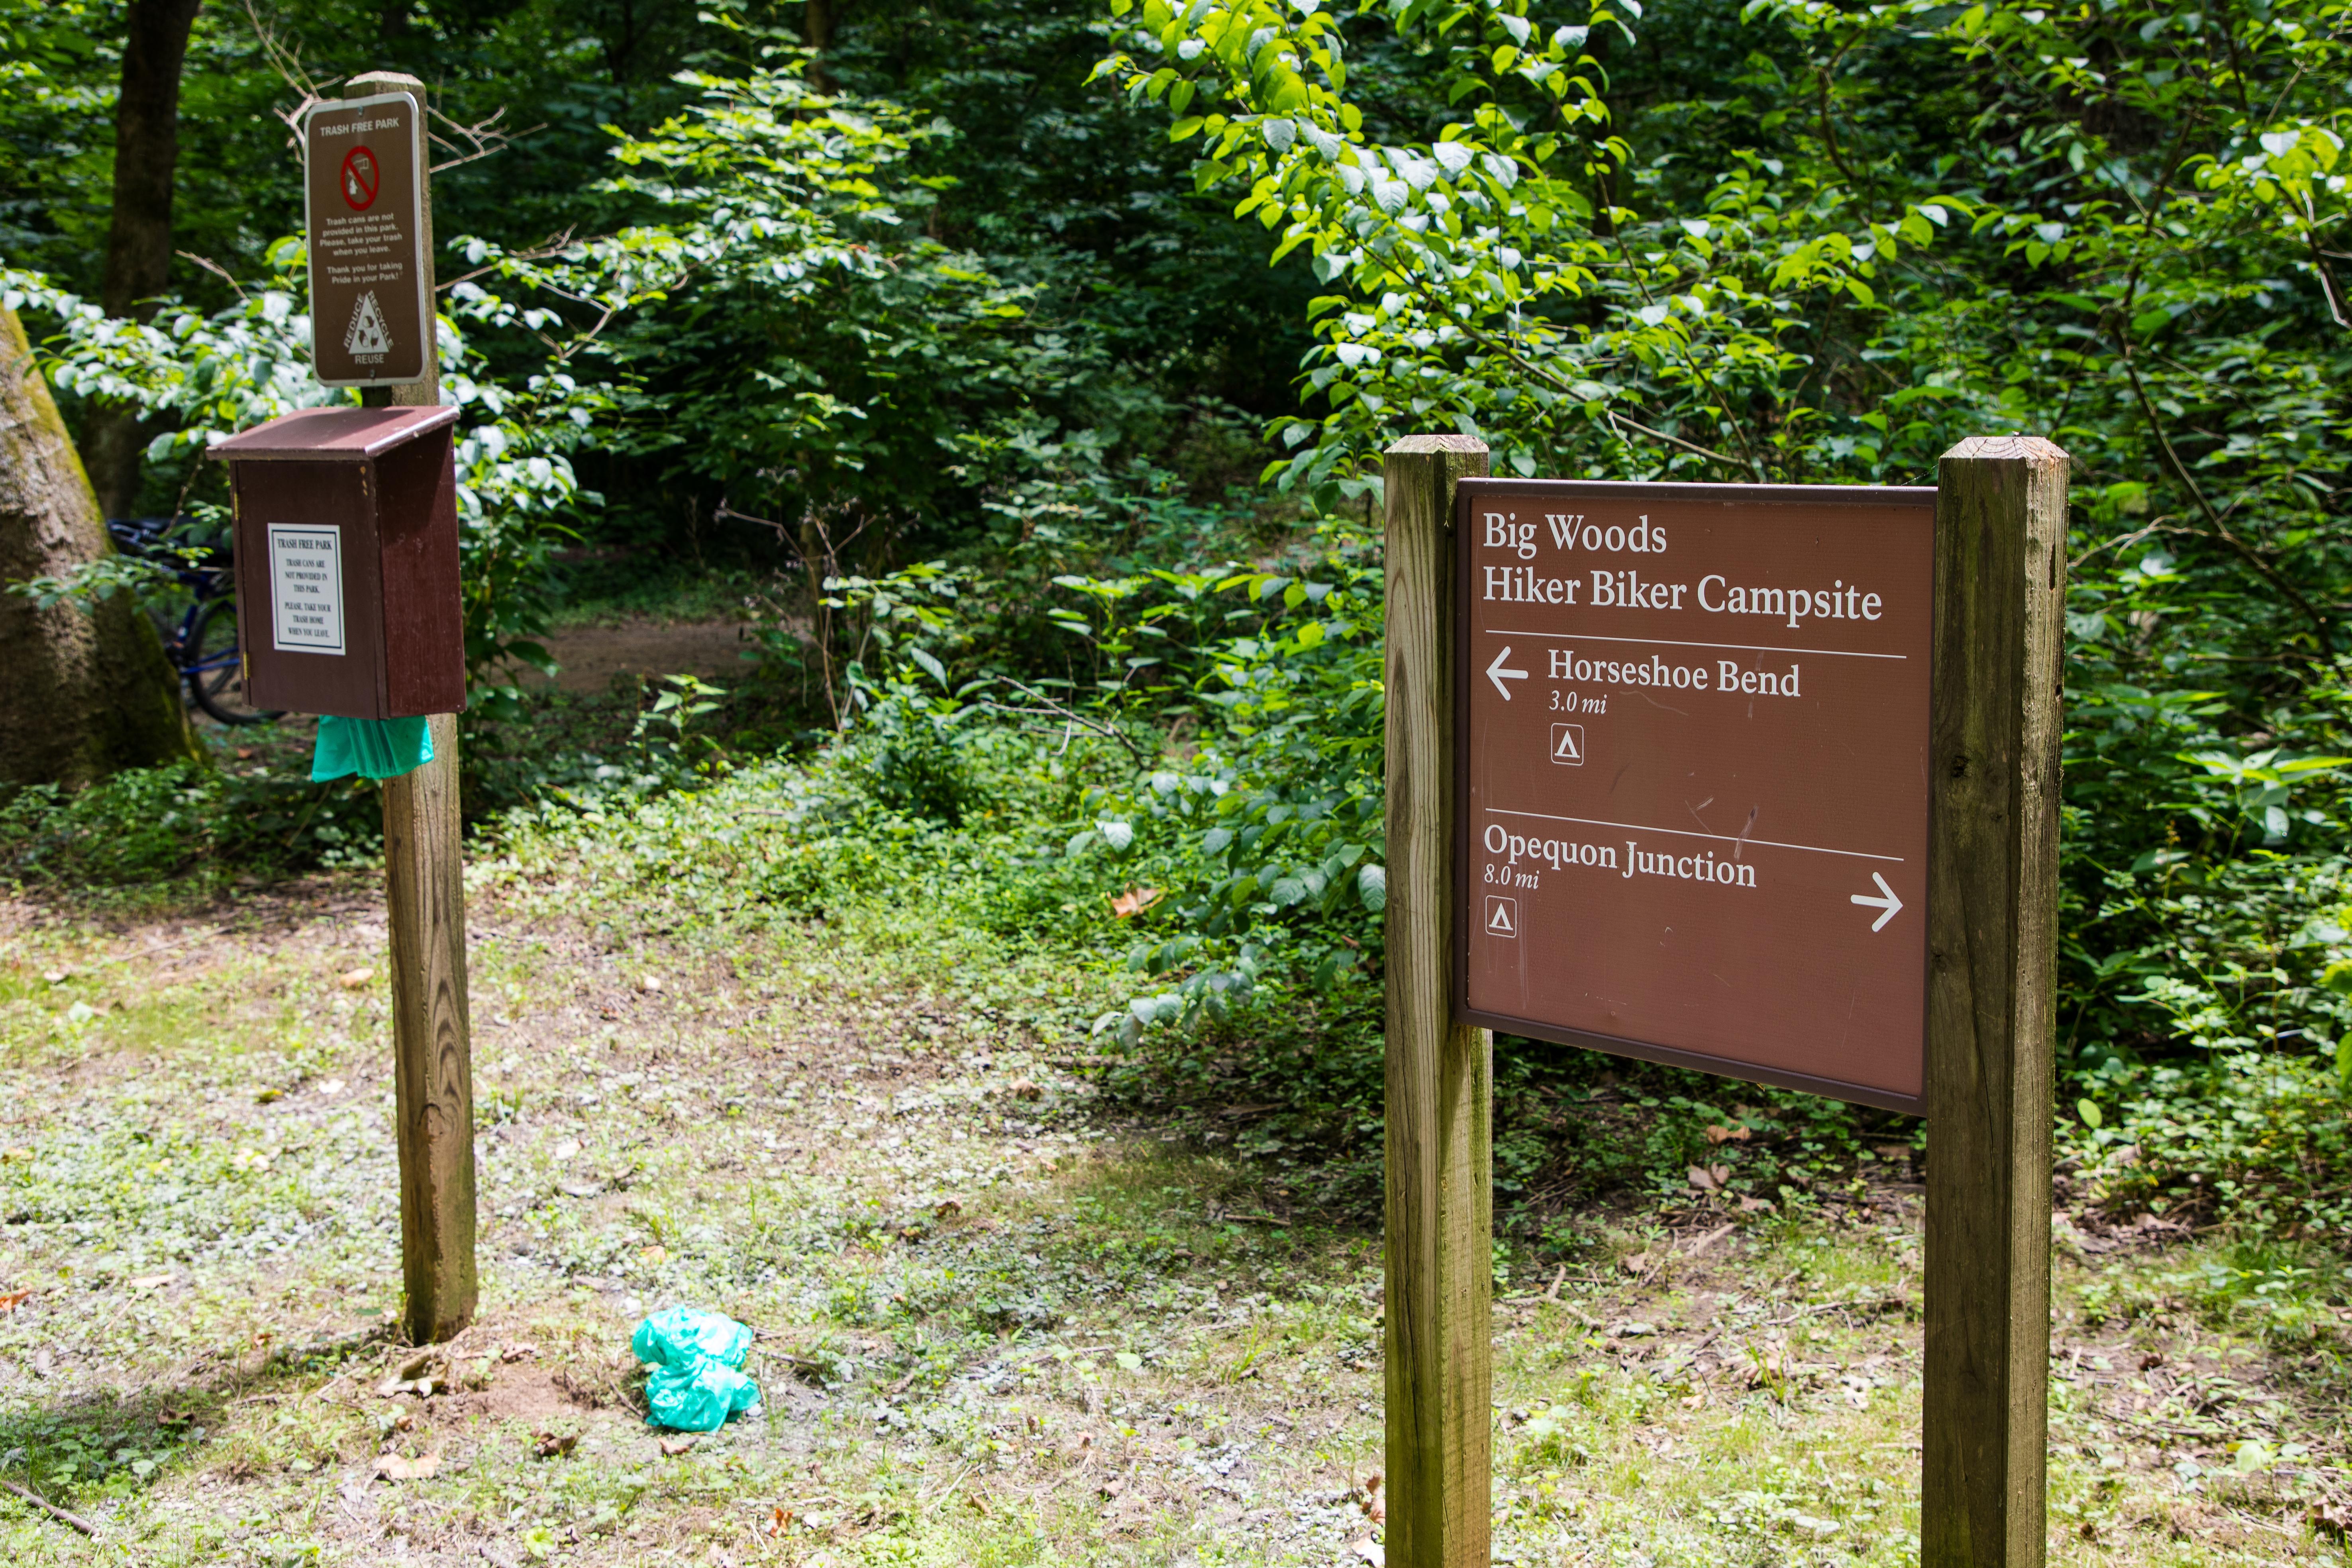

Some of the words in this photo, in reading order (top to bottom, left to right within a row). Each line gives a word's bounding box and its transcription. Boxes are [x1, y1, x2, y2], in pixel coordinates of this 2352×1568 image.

[320, 124, 349, 136] TRASH
[352, 121, 373, 133] FREE
[376, 118, 399, 129] PARK
[323, 227, 354, 237] provided
[354, 247, 368, 255] you
[327, 266, 350, 274] Thank
[379, 262, 402, 271] taking
[332, 275, 351, 284] Pride
[362, 275, 378, 283] your
[343, 292, 365, 348] REDUCE
[368, 290, 394, 349] RECYCLE
[355, 354, 384, 364] REUSE
[1483, 512, 1537, 559] Big
[1546, 514, 1667, 553] Woods
[278, 538, 297, 548] TRASH
[299, 539, 314, 549] FREE
[316, 540, 332, 550] PARK
[296, 572, 320, 580] PROVIDED
[1483, 566, 1581, 604] Hiker
[1590, 571, 1687, 610] Biker
[1697, 575, 1882, 628] Campsite
[310, 616, 324, 624] HOME
[288, 627, 302, 636] WHEN
[1548, 649, 1708, 689] Horseshoe
[1716, 660, 1801, 697] Bend
[1550, 691, 1577, 712] 3.0
[1582, 694, 1607, 714] mi
[1484, 824, 1617, 871] Opequon
[1623, 841, 1757, 888] Junction
[1484, 864, 1511, 885] 8.0
[1516, 867, 1539, 890] mi
